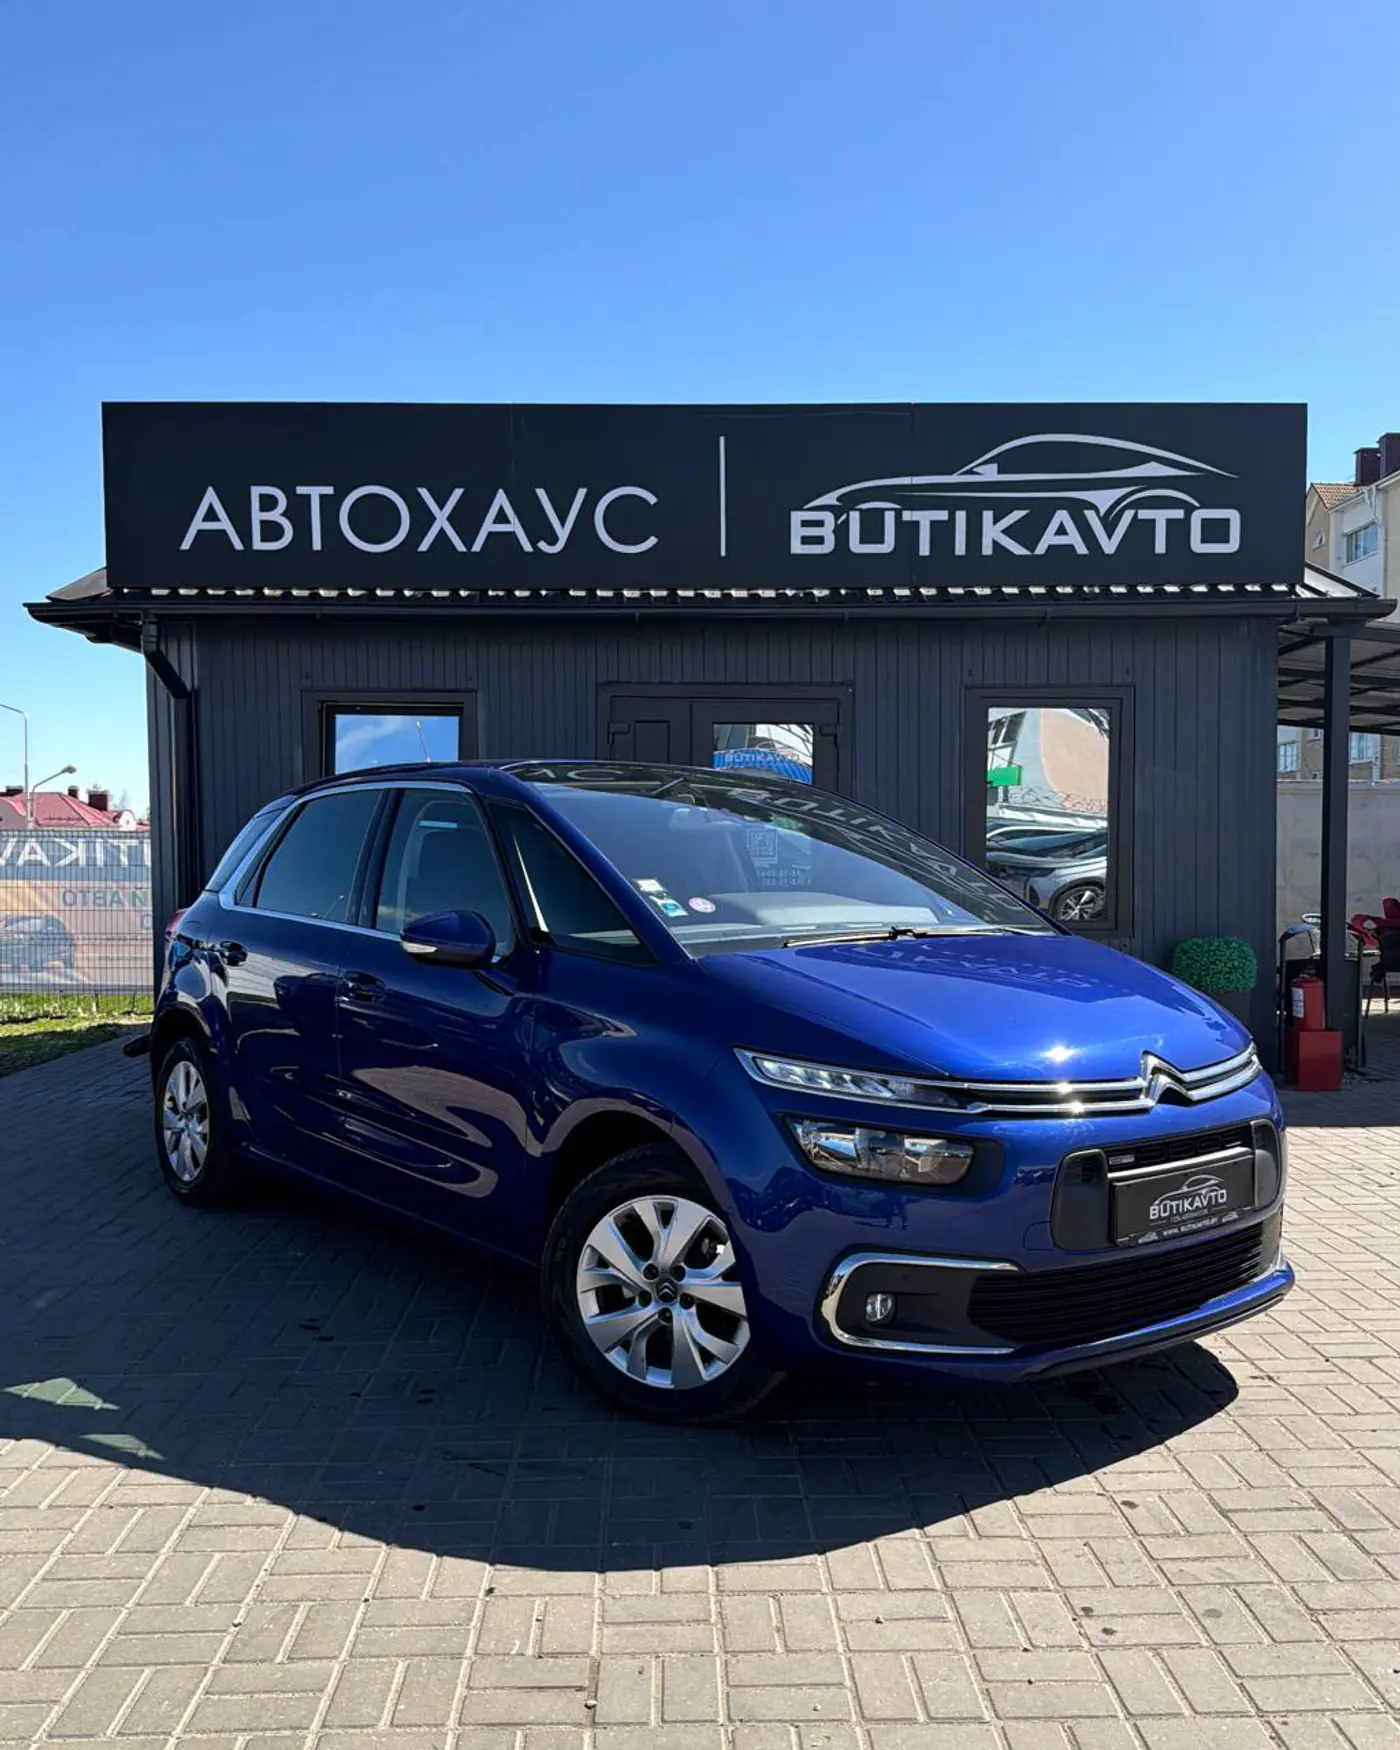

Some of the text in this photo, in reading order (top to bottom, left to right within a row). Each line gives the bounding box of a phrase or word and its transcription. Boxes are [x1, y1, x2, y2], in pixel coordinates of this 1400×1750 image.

[181, 485, 658, 554] АВТОХАУС
[791, 509, 1241, 556] BUTIKAVTO
[1150, 1189, 1227, 1219] BUTIKAVTO
